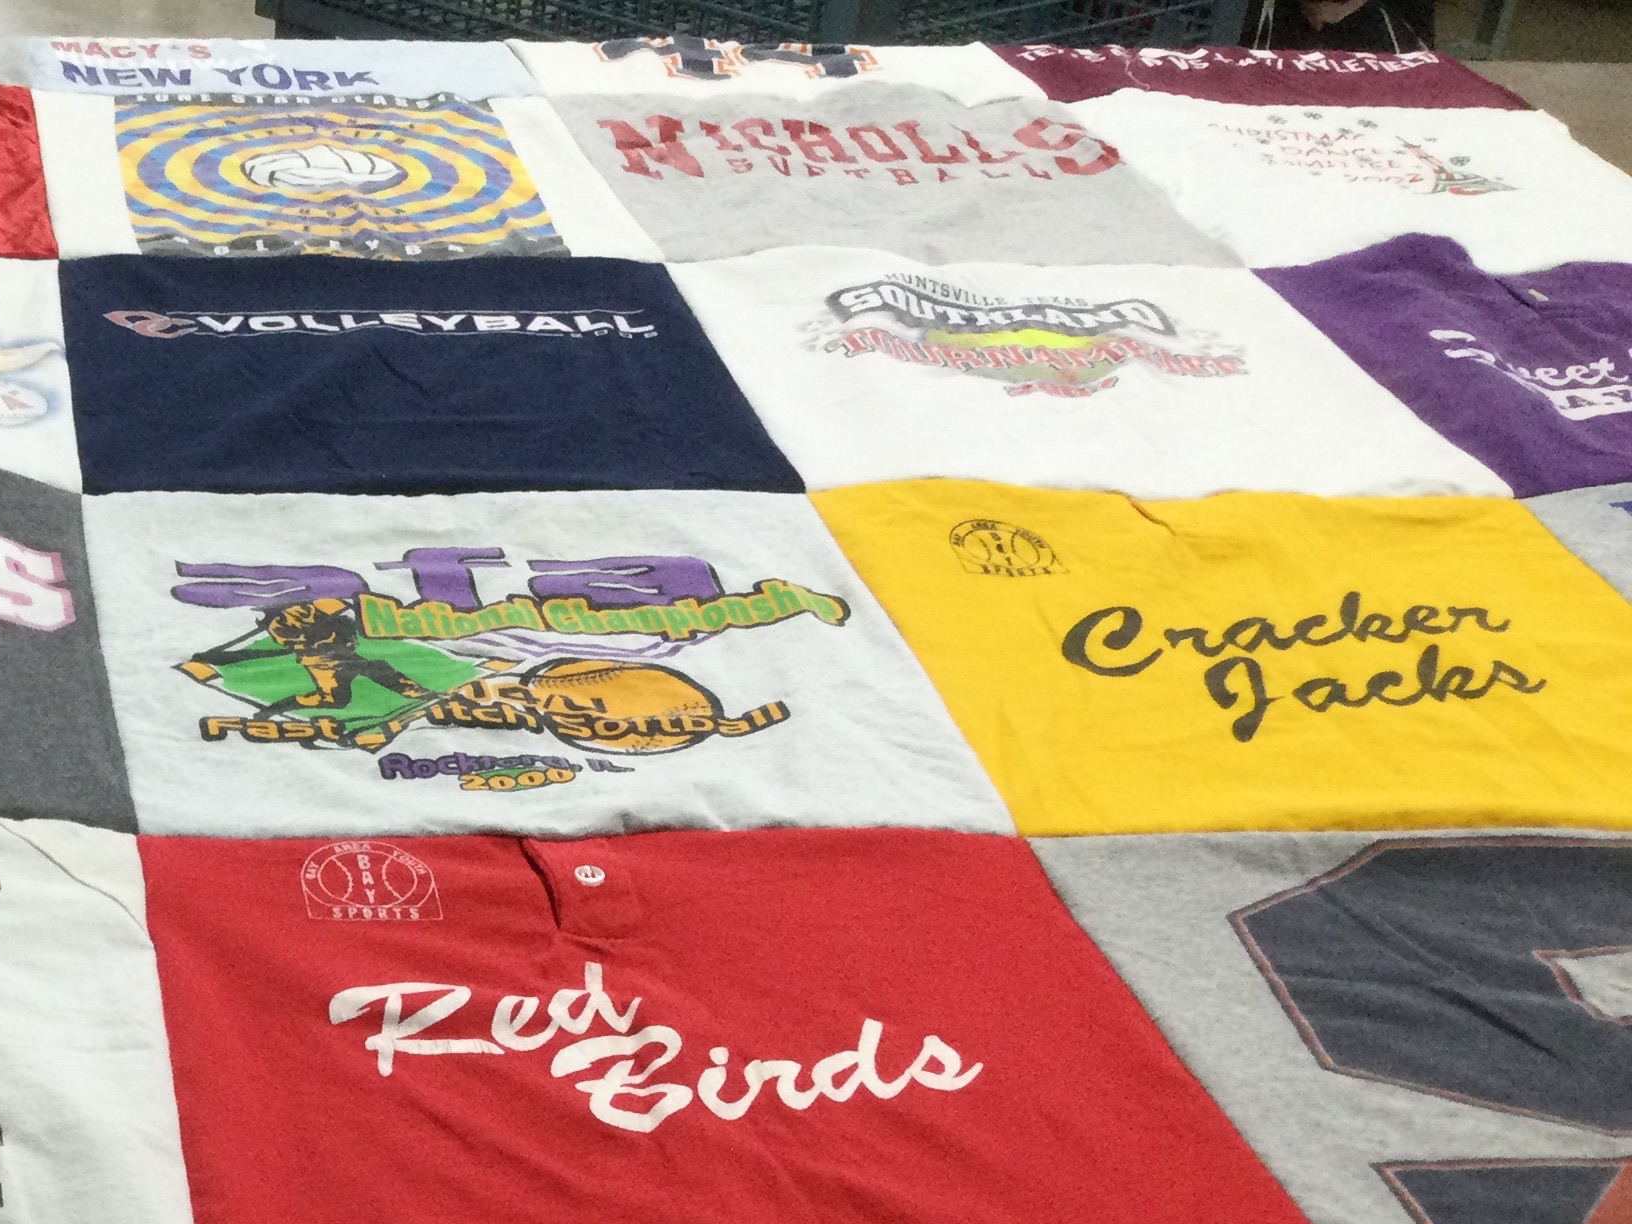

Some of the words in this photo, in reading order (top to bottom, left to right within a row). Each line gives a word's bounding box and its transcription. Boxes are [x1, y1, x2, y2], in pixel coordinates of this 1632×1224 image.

[51, 41, 211, 62] MACY'S
[60, 60, 192, 88] NEW
[214, 63, 380, 91] YORK
[597, 113, 1127, 180] NICHOLLS
[195, 311, 657, 337] VOLLEYBALL
[839, 284, 1166, 332] SOUTHLAND
[357, 593, 546, 641] National
[1060, 591, 1511, 678] Cracker
[1204, 643, 1547, 743] Jacks
[199, 711, 342, 743] Fast
[542, 701, 791, 743] Softball
[458, 766, 576, 792] 2000
[331, 906, 420, 921] SPORTS
[328, 960, 643, 1078] Red
[549, 1017, 985, 1135] Birds
